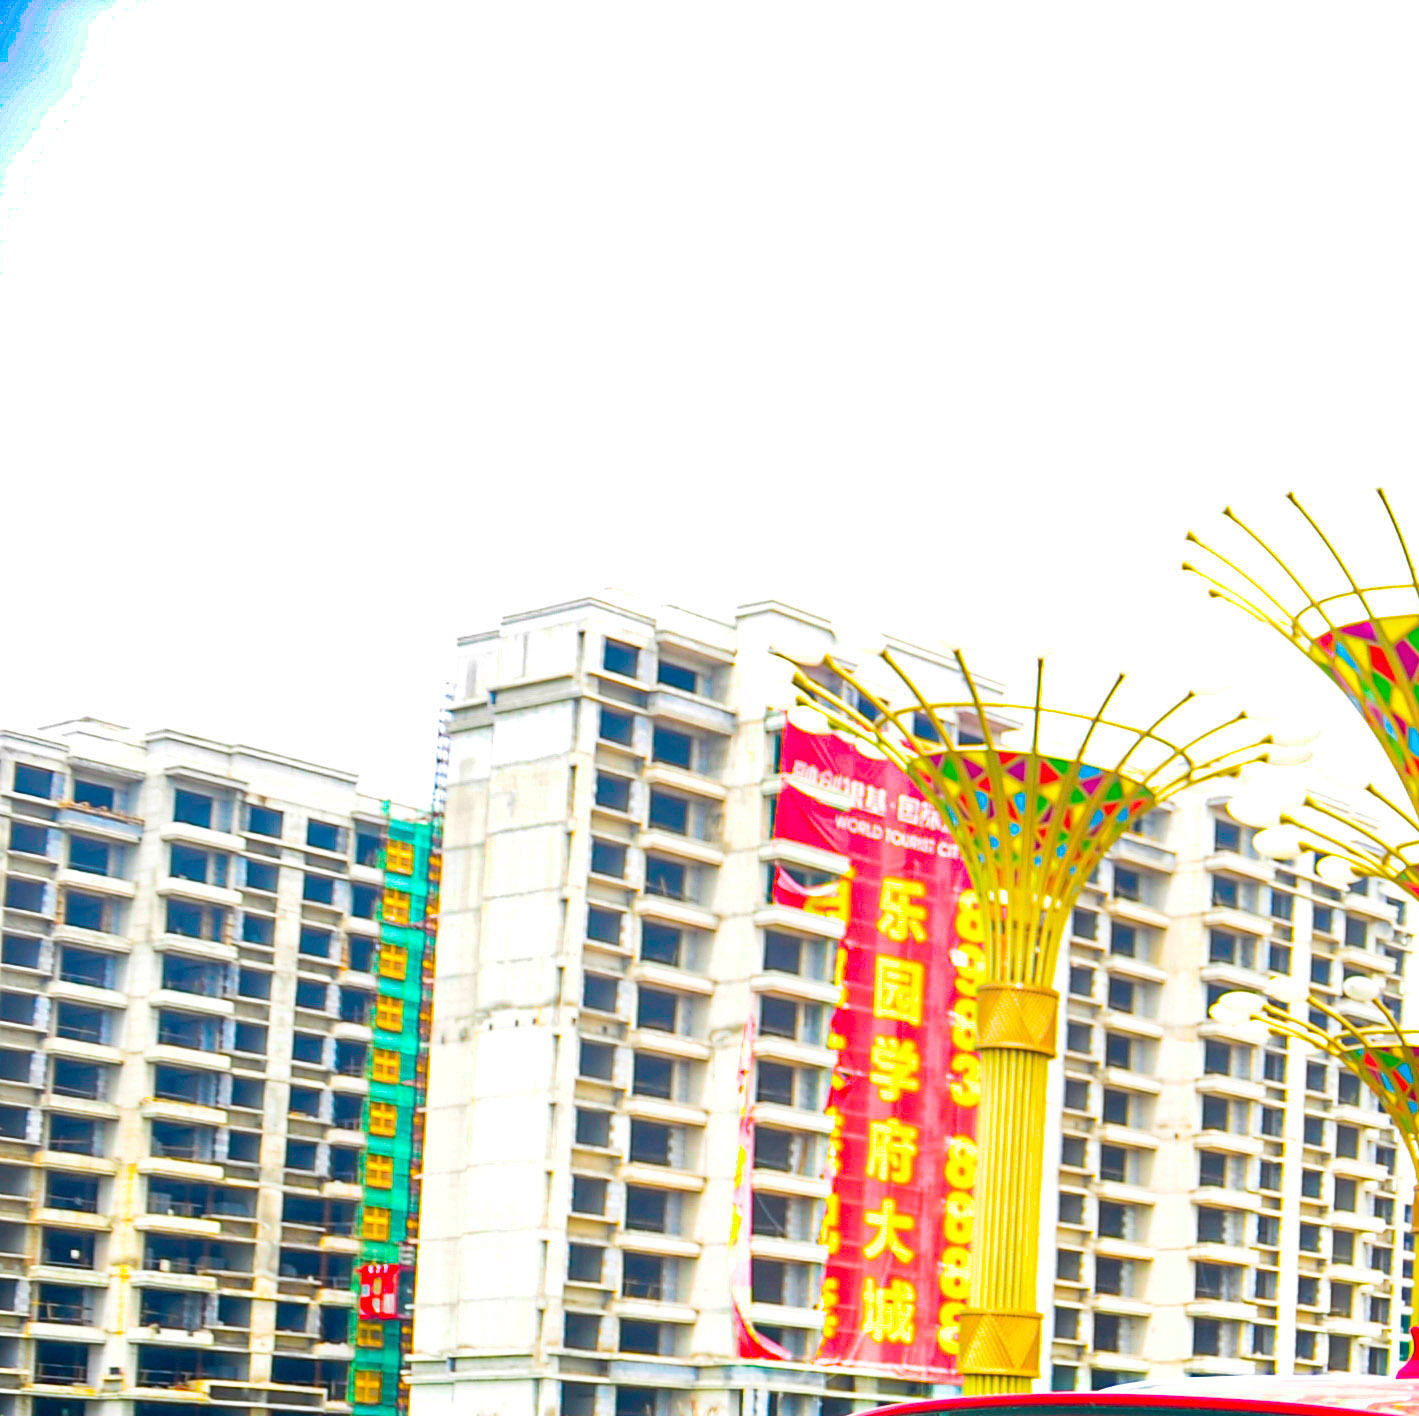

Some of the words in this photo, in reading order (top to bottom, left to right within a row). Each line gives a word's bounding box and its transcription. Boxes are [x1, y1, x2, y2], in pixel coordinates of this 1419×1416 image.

[835, 813, 884, 841] WORLD
[885, 827, 936, 855] TOURIST
[936, 840, 960, 860] CIT
[862, 876, 927, 1344] 乐园学府大城
